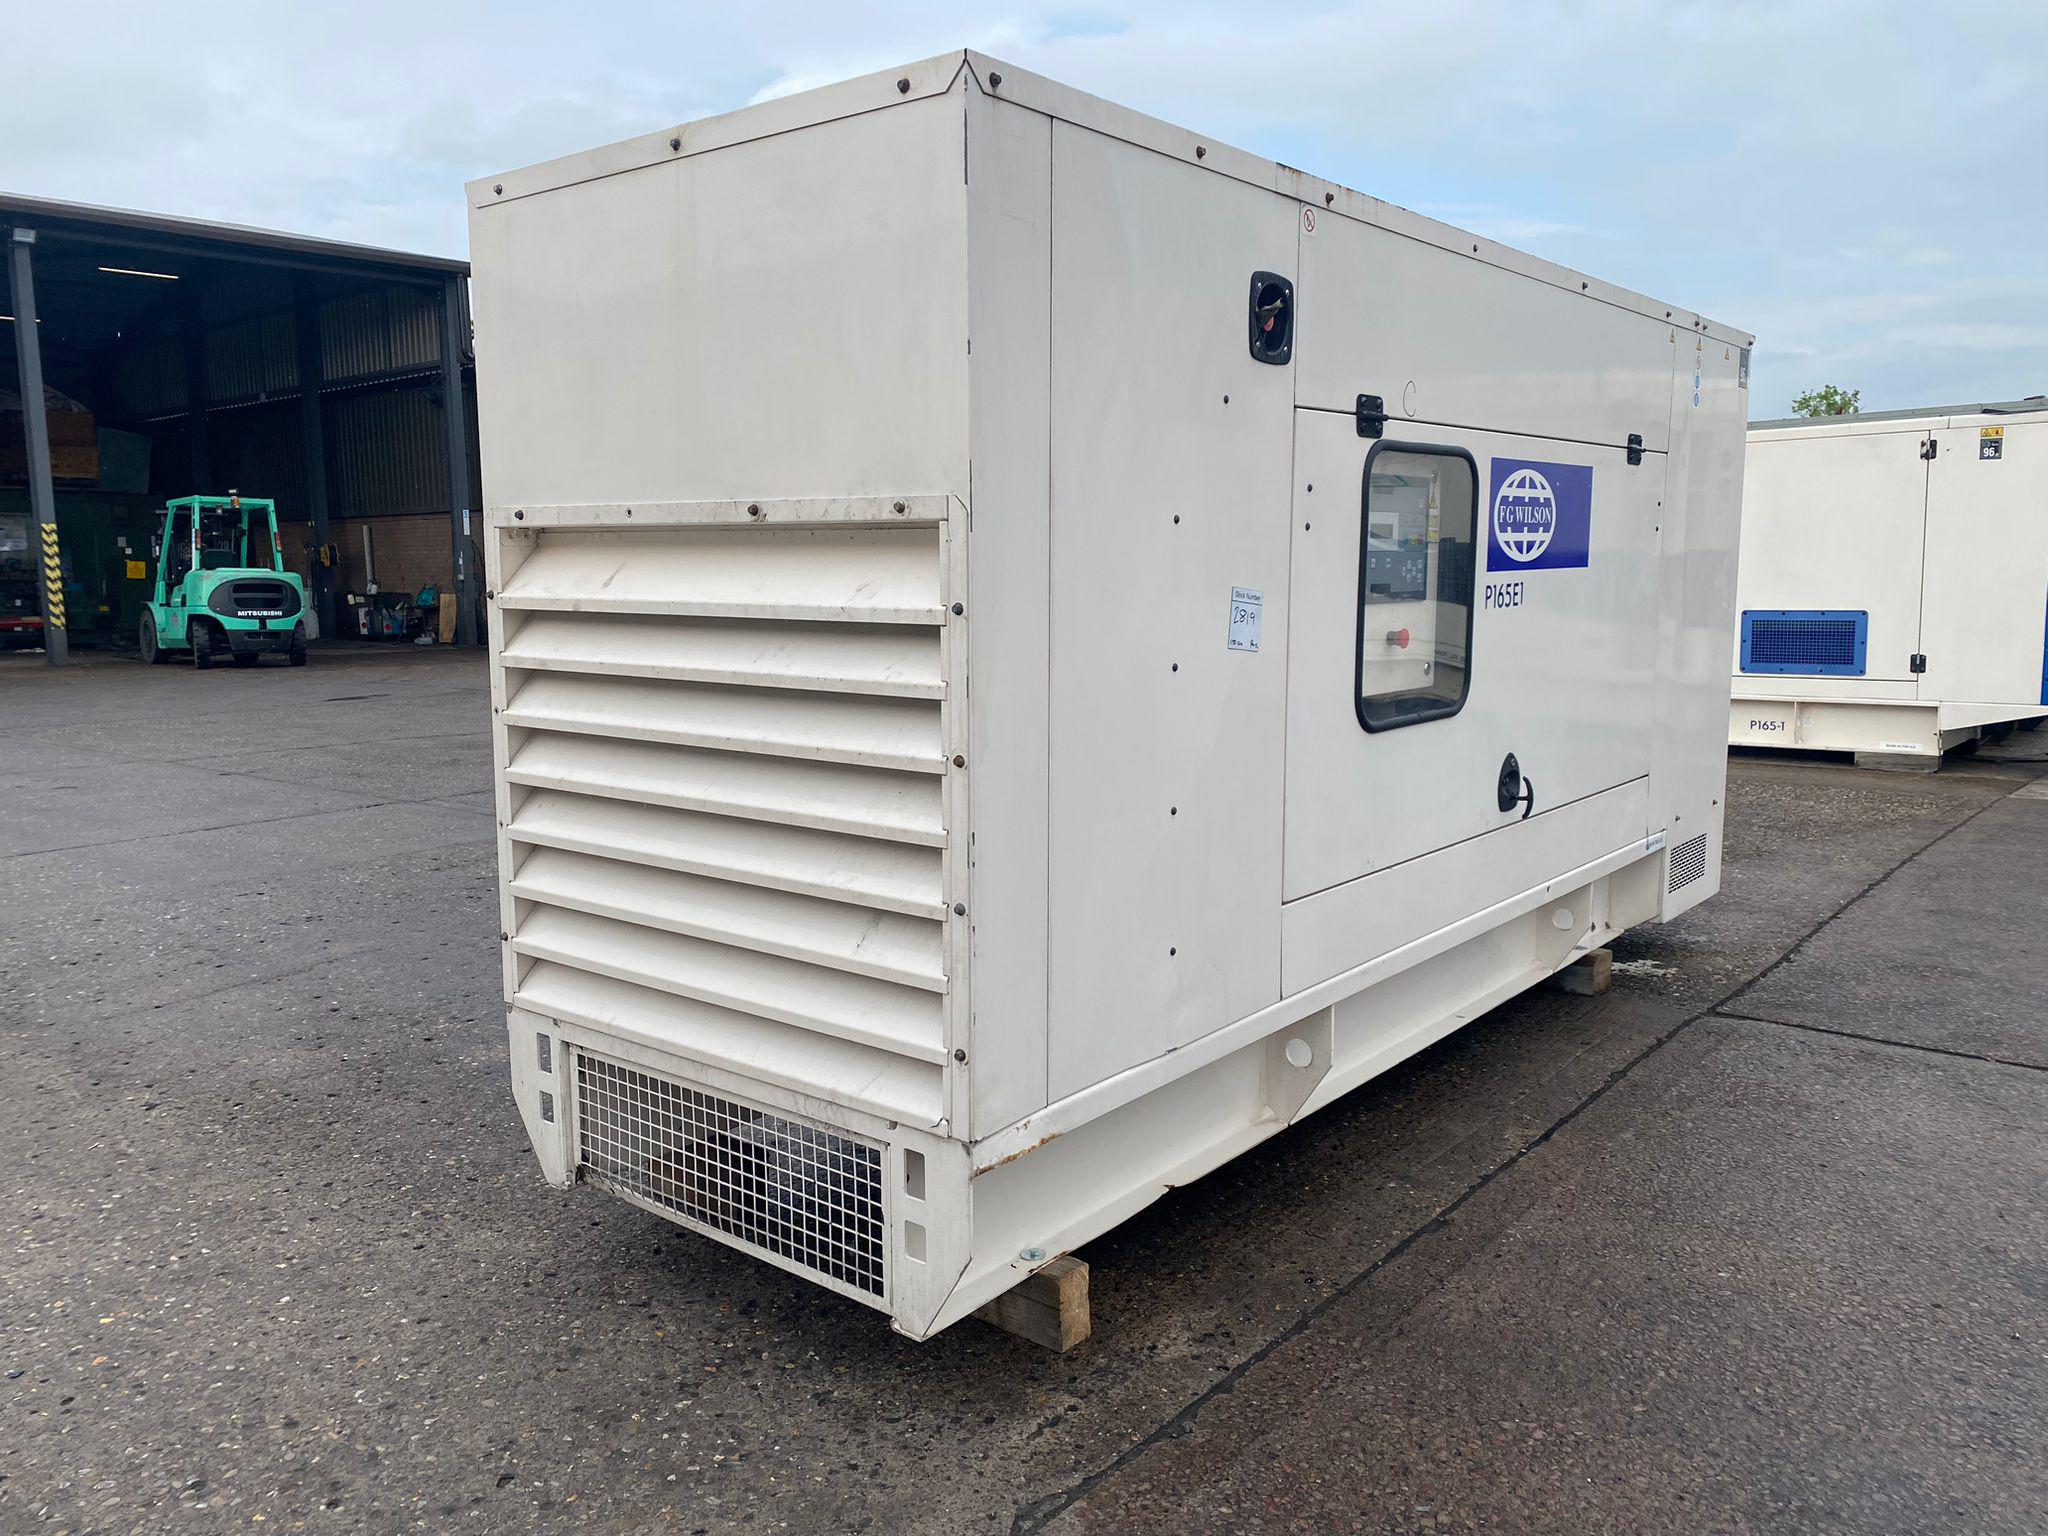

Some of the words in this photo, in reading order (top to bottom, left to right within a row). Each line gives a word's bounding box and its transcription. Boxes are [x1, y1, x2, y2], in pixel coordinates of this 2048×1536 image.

[1983, 447, 1995, 458] 96
[1499, 505, 1514, 523] FG
[1515, 506, 1552, 524] WILSON
[1484, 581, 1524, 610] P165E1
[1750, 720, 1785, 731] P165-1
